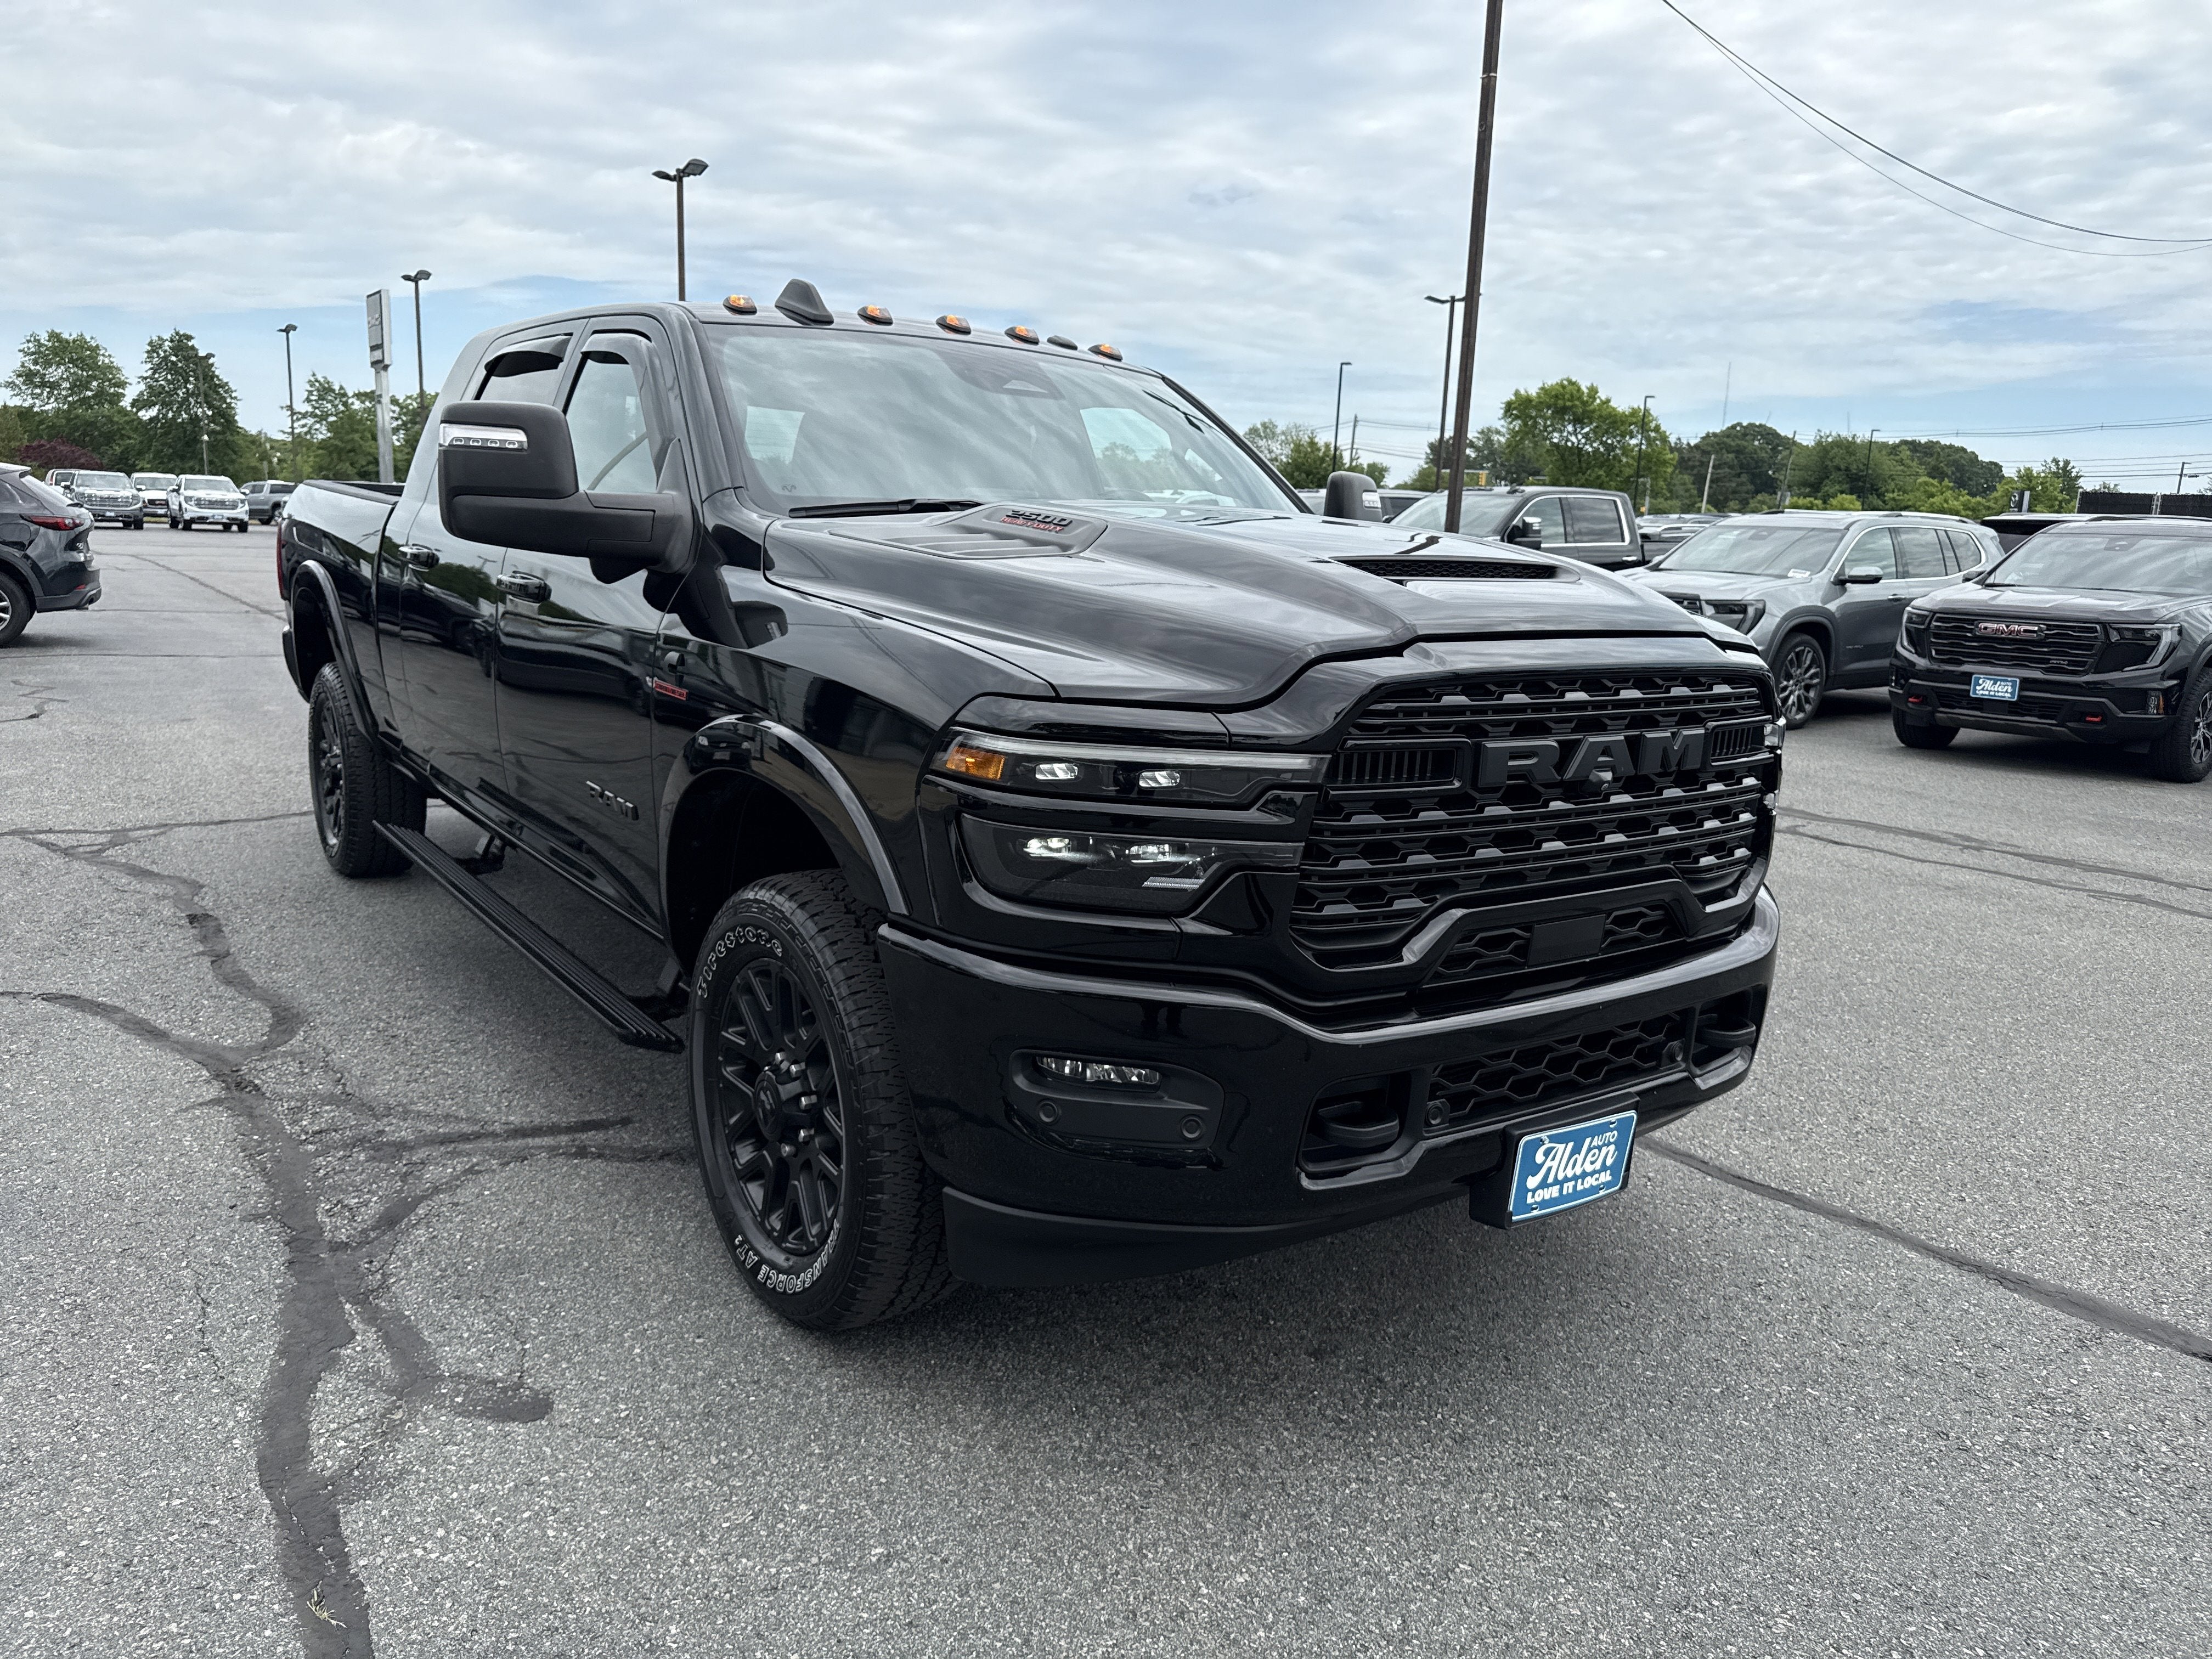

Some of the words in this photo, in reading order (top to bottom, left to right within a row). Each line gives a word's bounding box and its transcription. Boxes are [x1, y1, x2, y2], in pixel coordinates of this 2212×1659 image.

[1000, 517, 1034, 527] HEAVY
[1032, 523, 1064, 533] DUTY
[1006, 510, 1073, 527] 2500
[1978, 623, 2038, 637] GMC
[1976, 679, 2012, 692] Alden
[1479, 727, 1705, 787] RAM
[697, 926, 782, 998] Firestone
[1592, 1130, 1617, 1147] AUTO
[1526, 1137, 1617, 1189] Alden
[1527, 1185, 1559, 1204] LOVE
[1564, 1181, 1575, 1195] IT
[1577, 1170, 1612, 1191] LOCAL
[757, 1218, 841, 1293] TRANSFORCE
